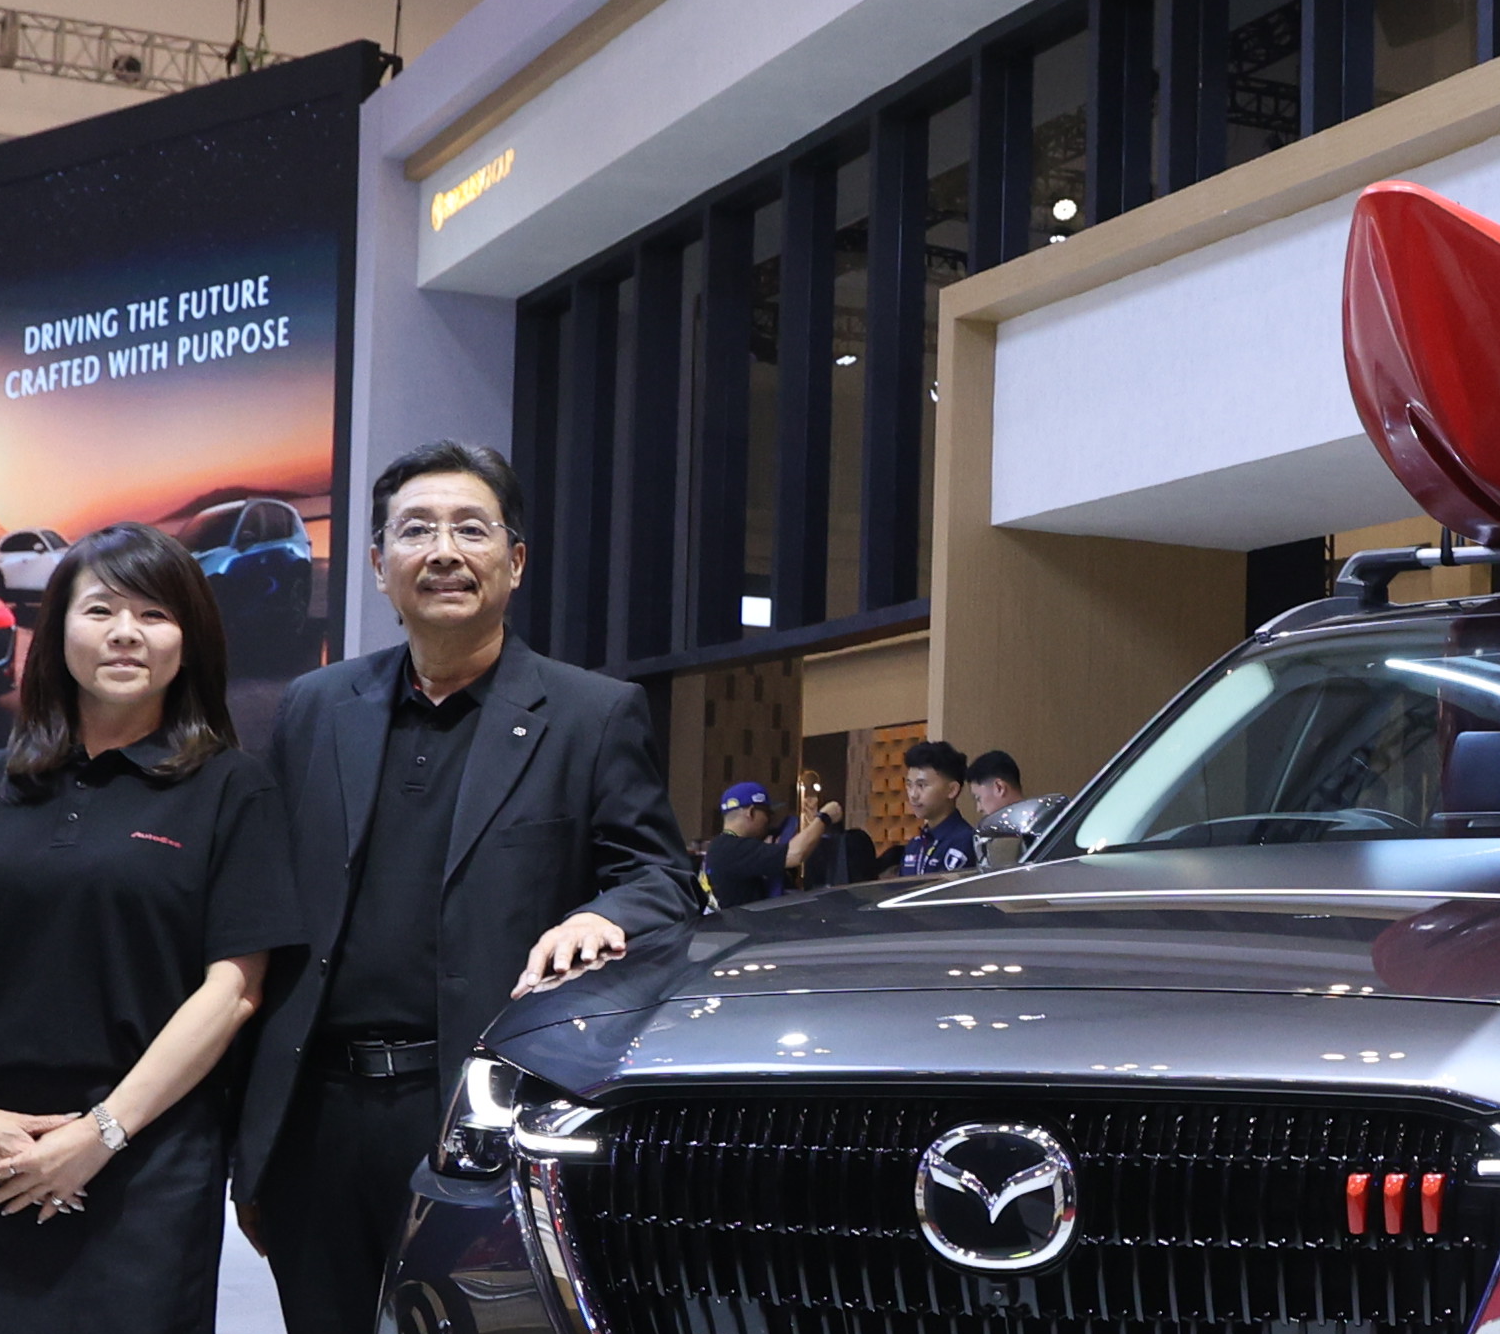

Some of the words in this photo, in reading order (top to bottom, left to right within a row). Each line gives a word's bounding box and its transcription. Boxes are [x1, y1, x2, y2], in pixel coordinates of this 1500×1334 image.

[24, 308, 118, 354] DRIVING
[127, 297, 169, 332] THE
[179, 275, 269, 322] FUTURE
[5, 356, 100, 399] CRAFTED
[108, 341, 168, 379] WITH
[178, 317, 290, 366] PURPOSE
